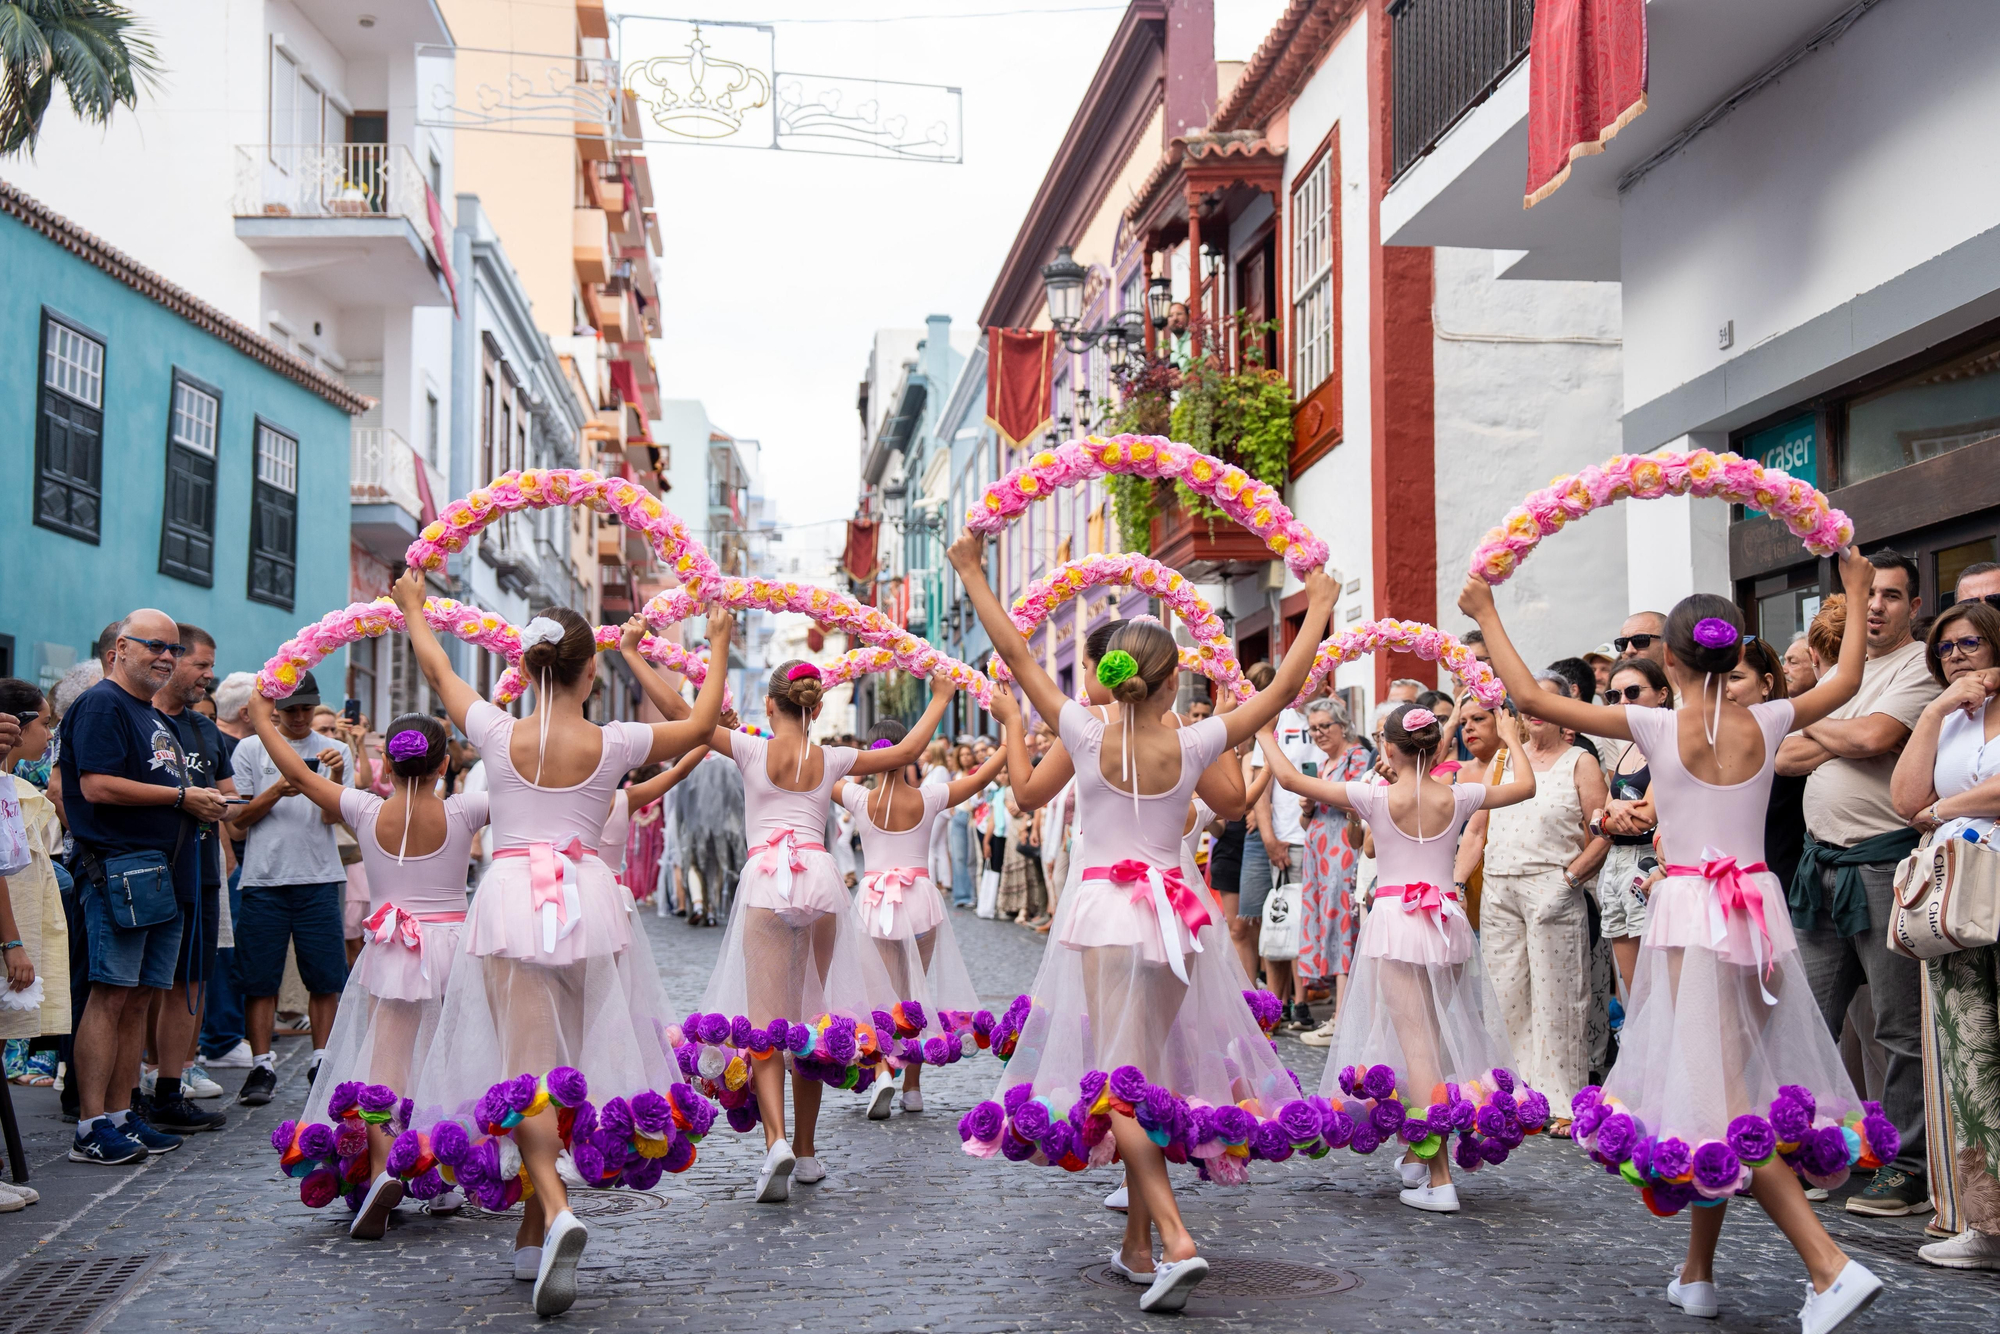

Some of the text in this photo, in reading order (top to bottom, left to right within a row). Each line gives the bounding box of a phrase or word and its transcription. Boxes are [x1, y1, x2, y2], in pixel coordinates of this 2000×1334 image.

[1766, 434, 1812, 471] caser
[1934, 854, 1946, 893] Chloé
[1929, 902, 1943, 940] Chloé
